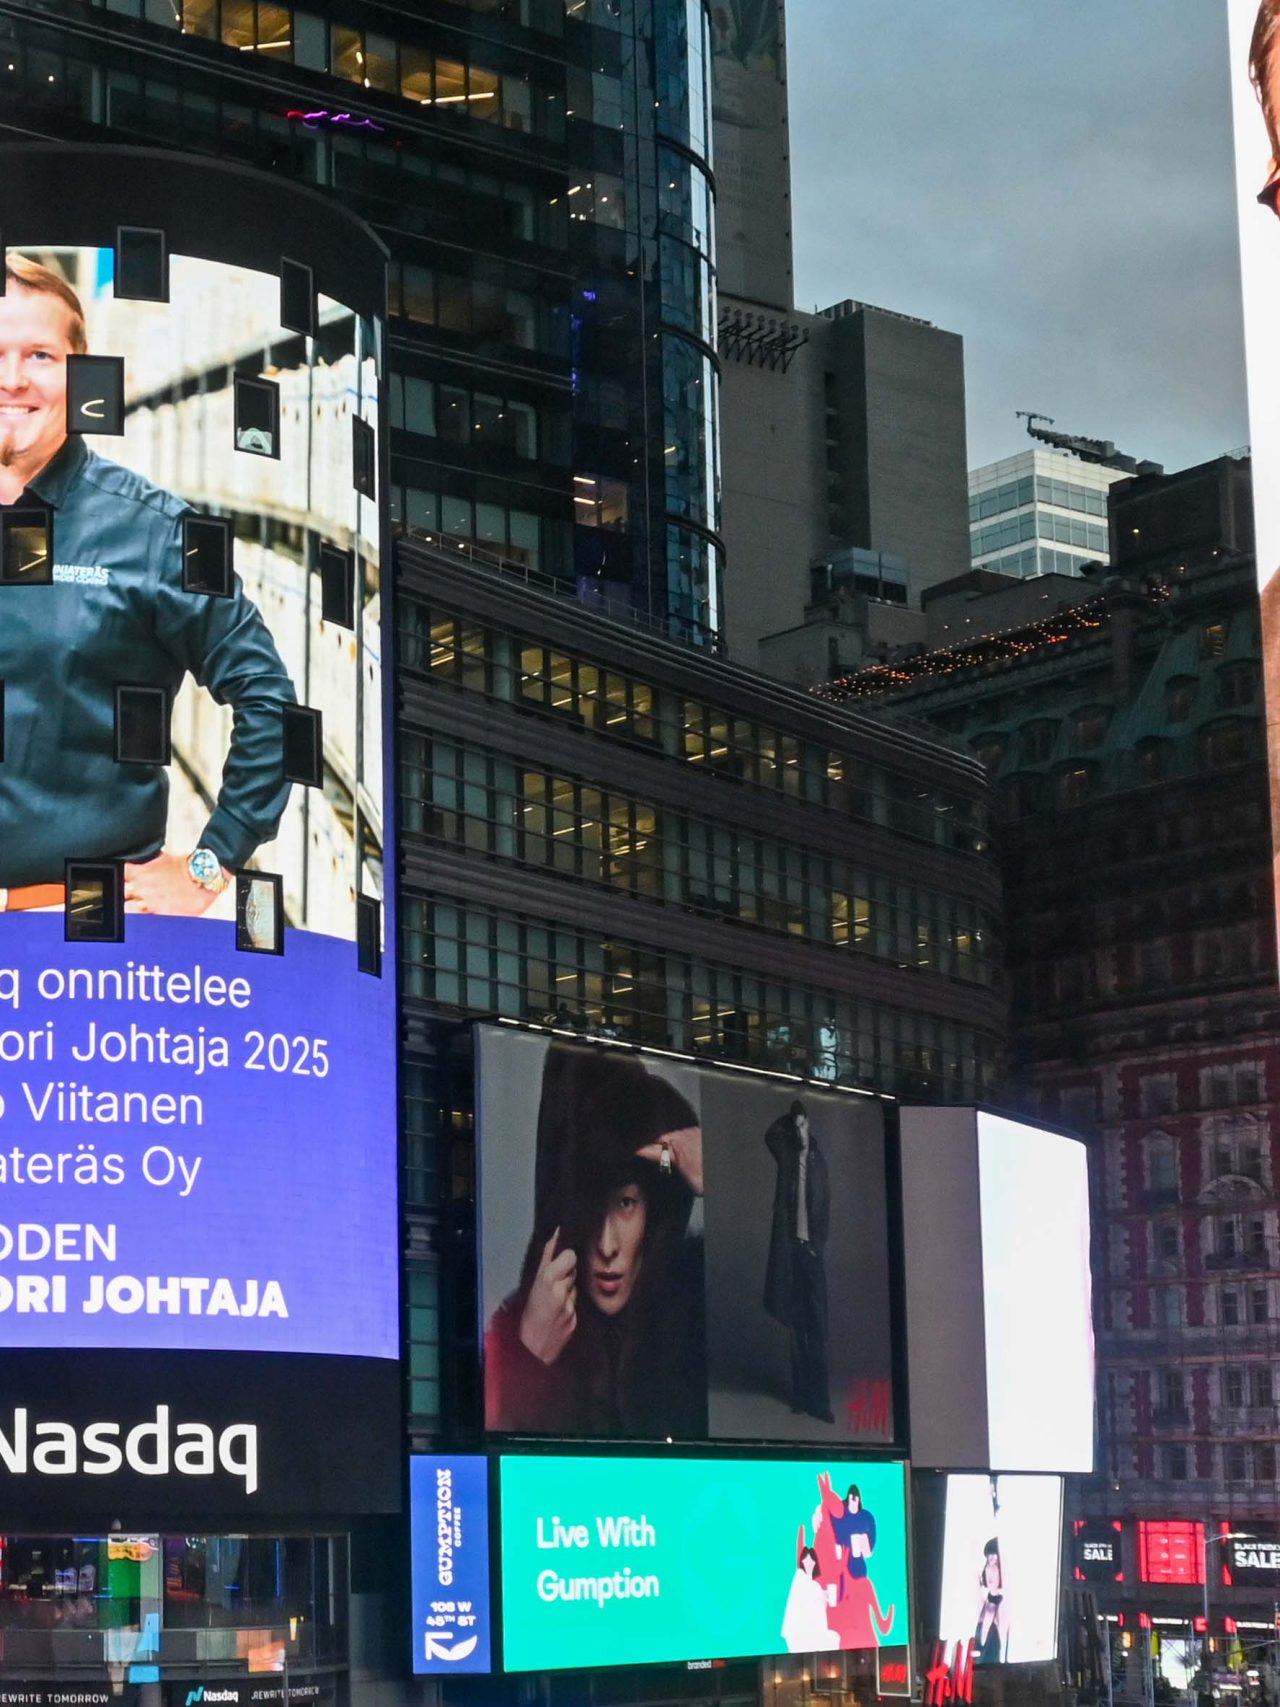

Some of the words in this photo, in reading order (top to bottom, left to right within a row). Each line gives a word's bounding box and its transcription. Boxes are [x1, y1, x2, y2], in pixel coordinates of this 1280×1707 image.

[37, 961, 251, 1009] onnittelee
[71, 1022, 229, 1075] Johtaja
[243, 1030, 329, 1078] 2025
[22, 1081, 203, 1125] Viitanen
[142, 1145, 202, 1197] Oy
[82, 1275, 289, 1319] JOHTAJA
[436, 1468, 454, 1586] GUMPTION
[453, 1507, 461, 1548] COFFEE
[536, 1515, 590, 1549] Live
[596, 1514, 656, 1548] With
[457, 1601, 472, 1613] W
[536, 1567, 660, 1608] Gumption
[47, 1693, 110, 1704] TOMORROW
[203, 1690, 239, 1703] Nasdaq
